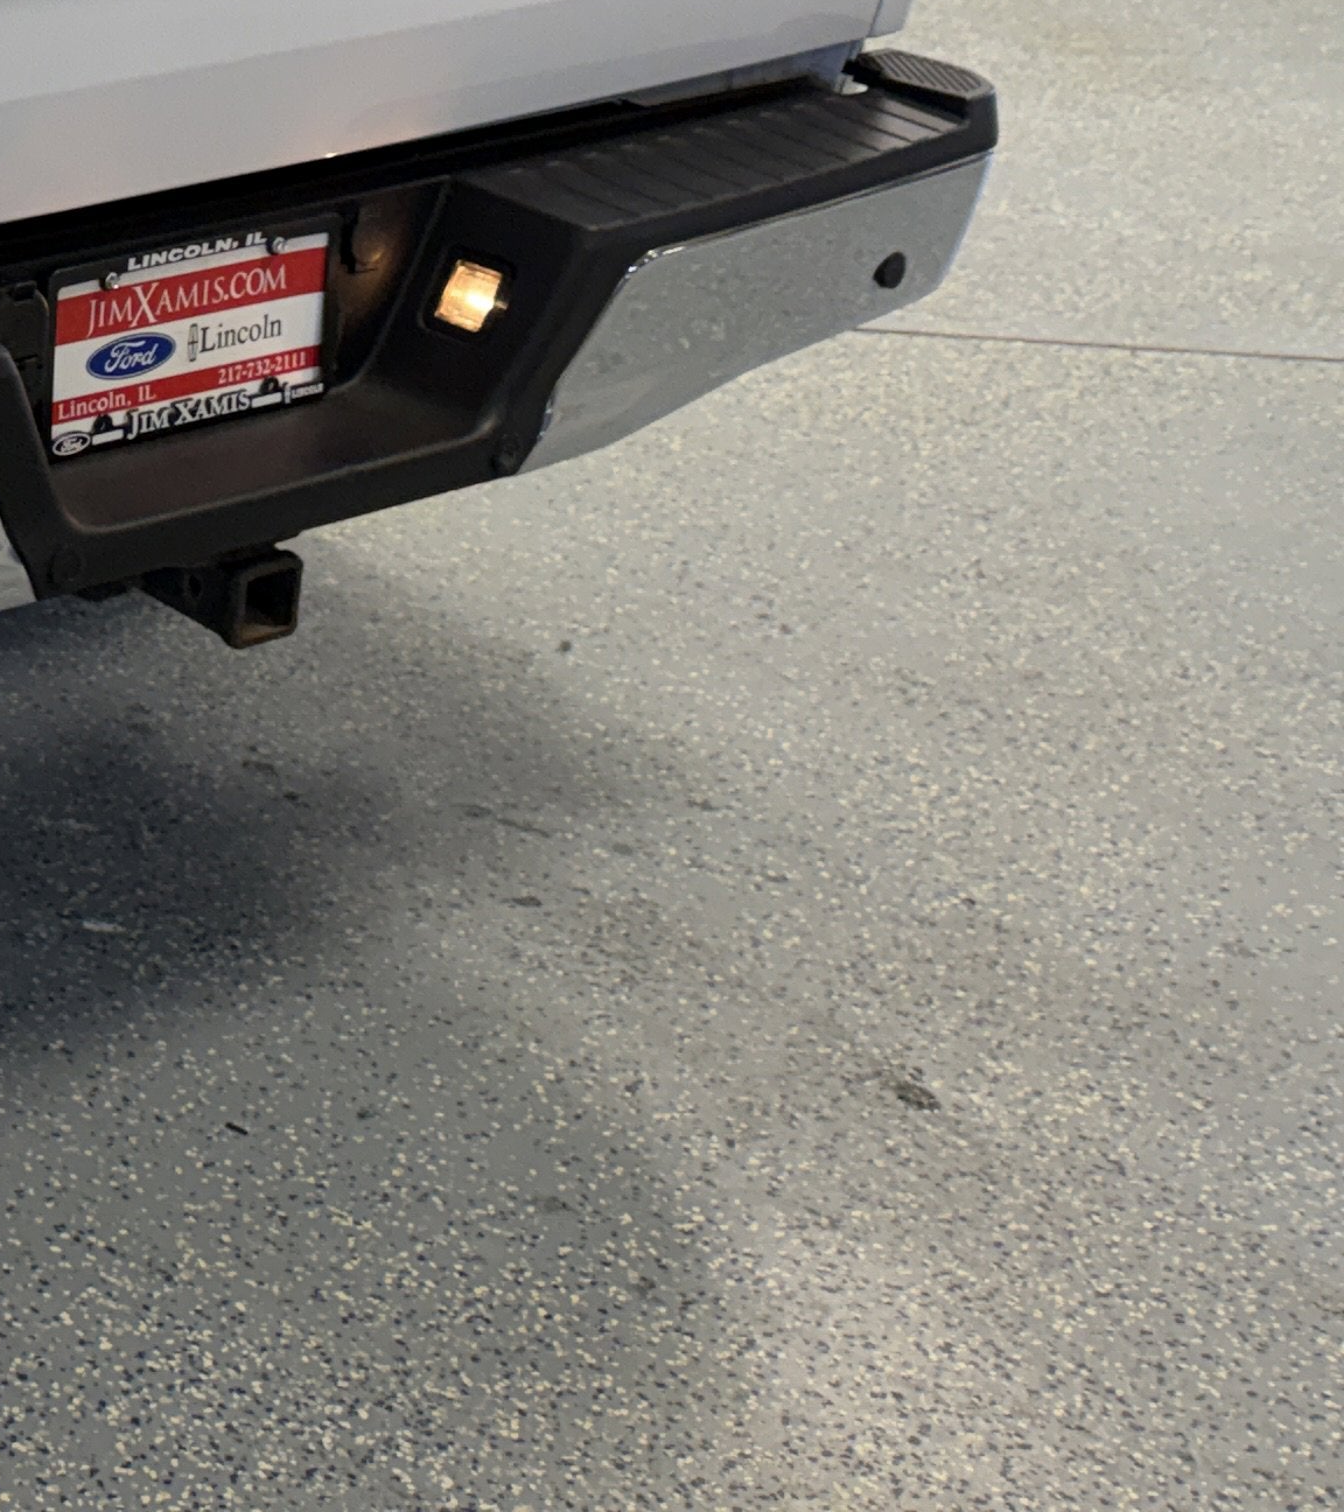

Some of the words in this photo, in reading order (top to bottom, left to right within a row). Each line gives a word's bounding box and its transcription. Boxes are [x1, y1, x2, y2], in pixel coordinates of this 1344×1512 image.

[127, 236, 238, 271] LINCOLN,
[200, 314, 282, 354] Lincoln
[103, 341, 157, 374] Ford
[216, 351, 307, 385] 217-732-2111
[57, 394, 132, 422] Lincoln,
[137, 385, 157, 403] IL
[126, 408, 170, 440] JIM
[174, 391, 252, 427] XAMIS
